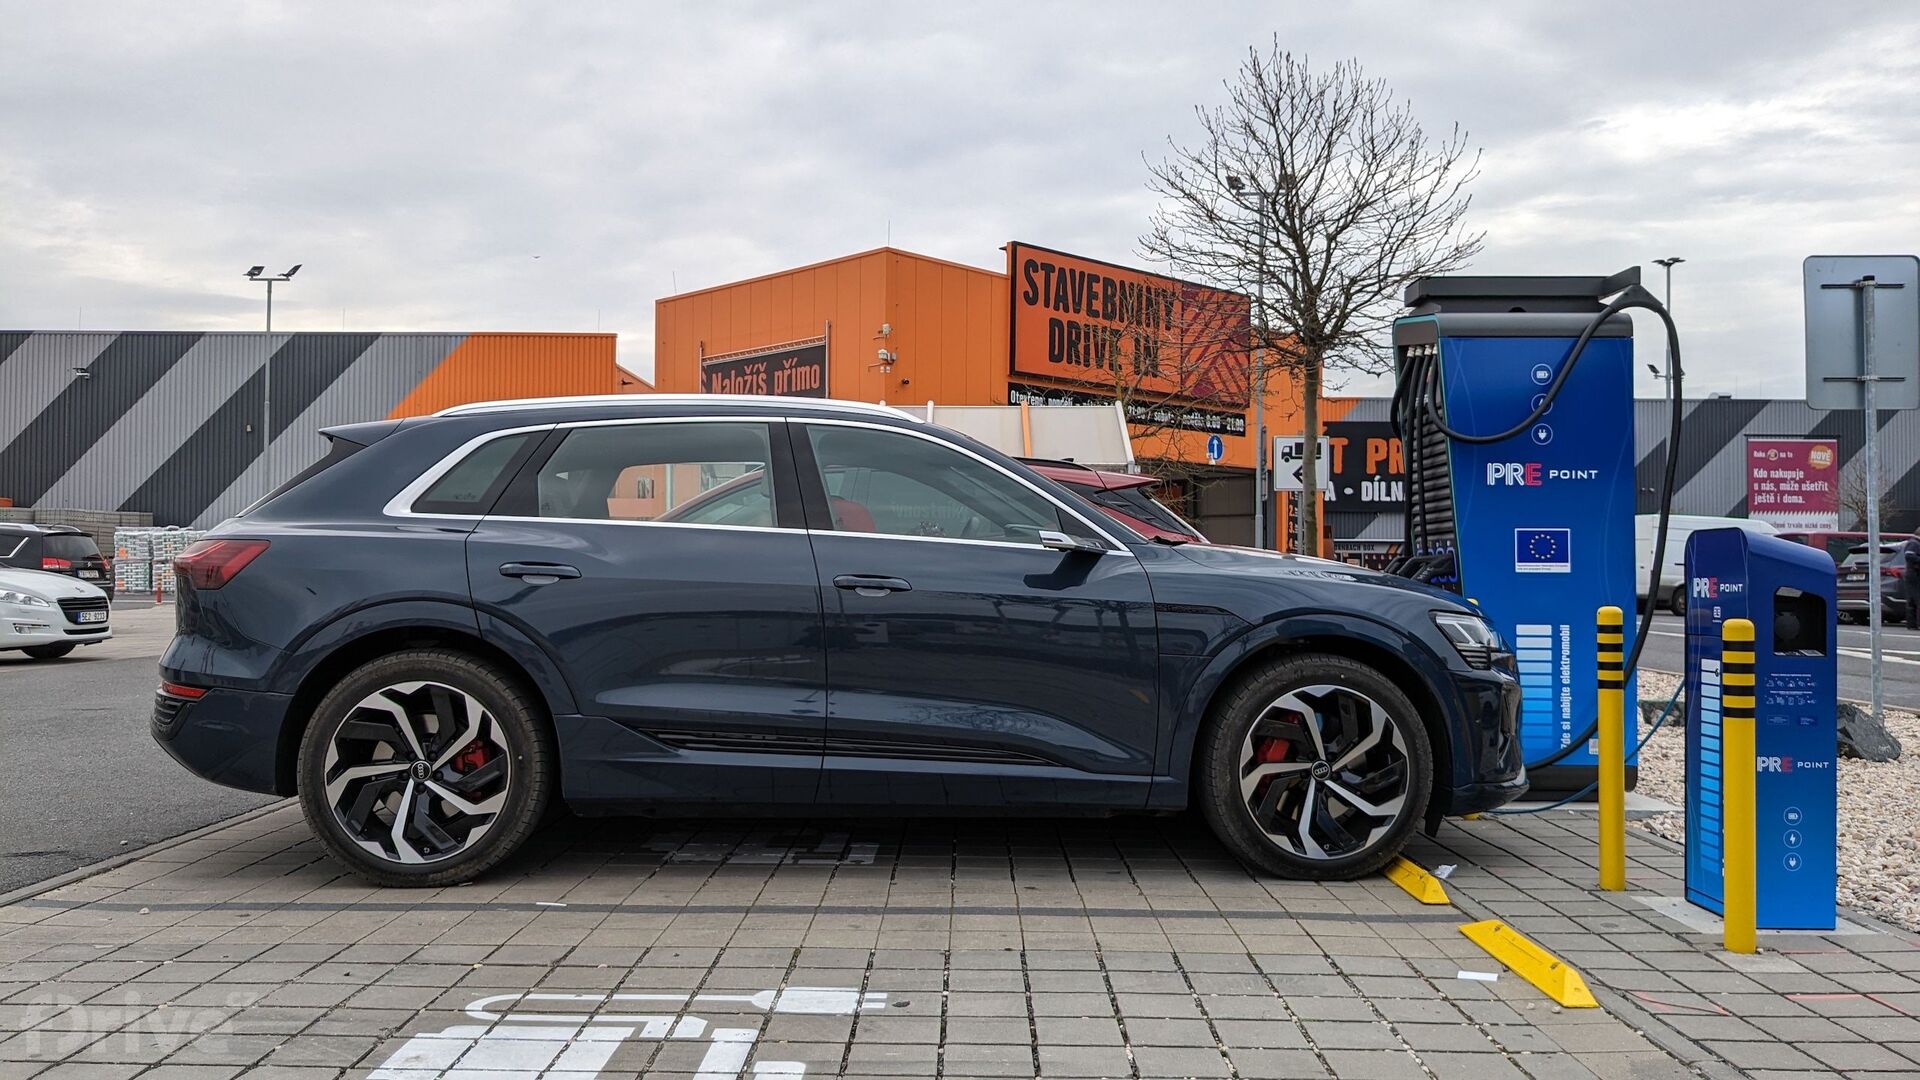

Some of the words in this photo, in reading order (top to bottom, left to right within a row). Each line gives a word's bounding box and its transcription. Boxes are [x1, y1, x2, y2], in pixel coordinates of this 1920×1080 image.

[1023, 259, 1177, 331] STAVEBNINY
[1048, 317, 1122, 372] DRIVE
[1134, 331, 1159, 378] IN
[773, 357, 821, 395] přímo
[1487, 462, 1542, 486] PRE
[1549, 469, 1599, 479] POINT
[1754, 468, 1768, 478] Kdo
[1770, 467, 1804, 481] nakupuje
[1753, 482, 1759, 491] u
[1761, 480, 1777, 492] nás,
[1780, 480, 1799, 491] může
[1802, 480, 1829, 492] ušetřit
[1754, 492, 1775, 506] ještě
[1782, 492, 1806, 504] doma.
[1692, 577, 1718, 599] PRE
[1719, 583, 1744, 593] POINT
[1560, 624, 1571, 684] elektromobil
[1560, 721, 1571, 730] si
[1756, 756, 1793, 773] PRE
[1797, 761, 1829, 769] POINT
